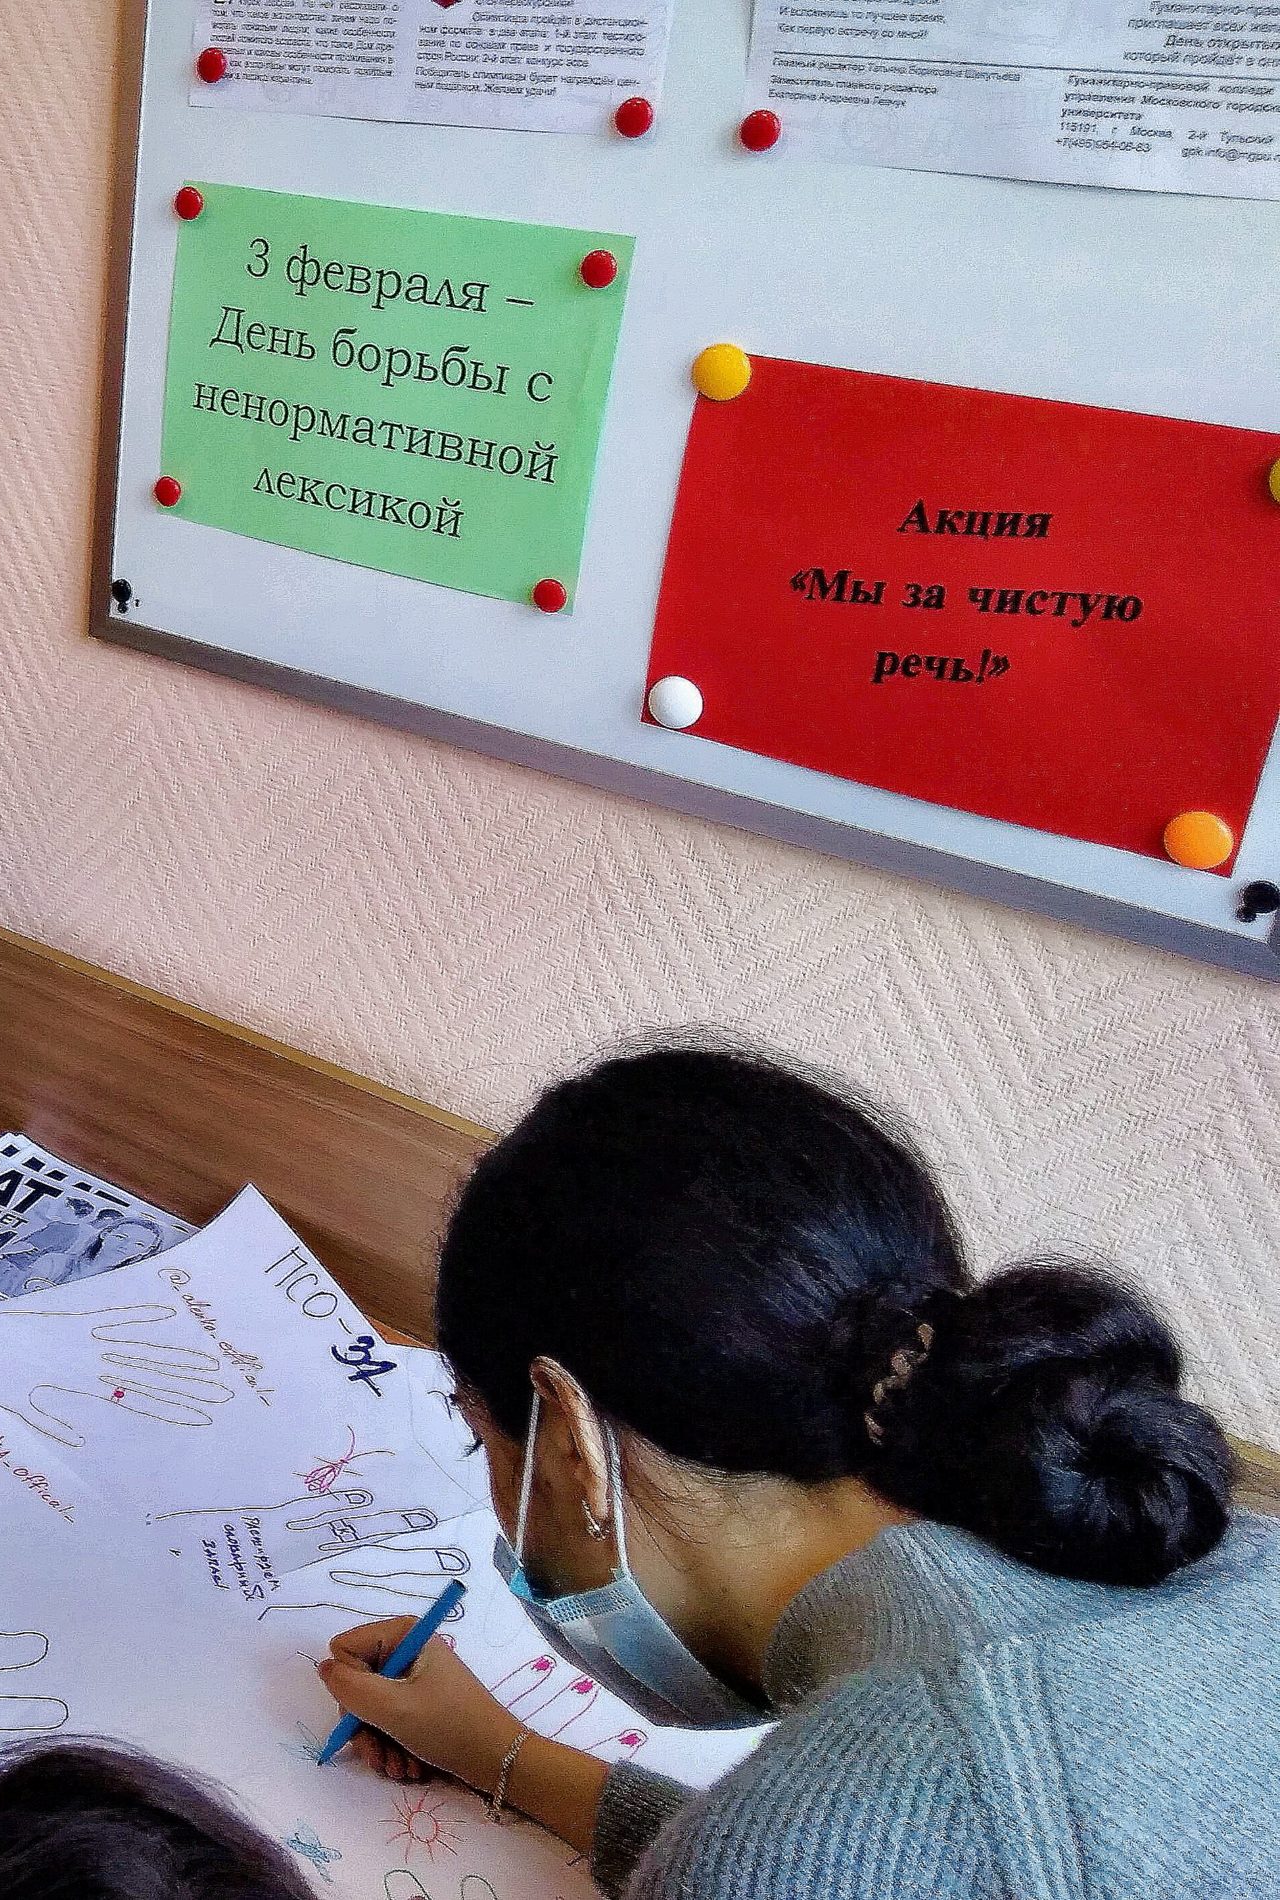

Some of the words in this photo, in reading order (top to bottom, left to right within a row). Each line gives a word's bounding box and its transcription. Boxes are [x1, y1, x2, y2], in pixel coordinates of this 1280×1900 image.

[246, 238, 270, 278] 3
[285, 244, 489, 312] февраля
[209, 306, 317, 360] День
[331, 328, 510, 395] борьбы
[527, 371, 553, 403] с
[192, 382, 559, 484] ненормативной
[253, 467, 465, 538] лексикой
[897, 499, 1053, 538] Акция
[790, 567, 887, 606] «Мы
[901, 583, 947, 609] за
[967, 586, 1143, 627] чистую
[871, 648, 1010, 684] речь!»
